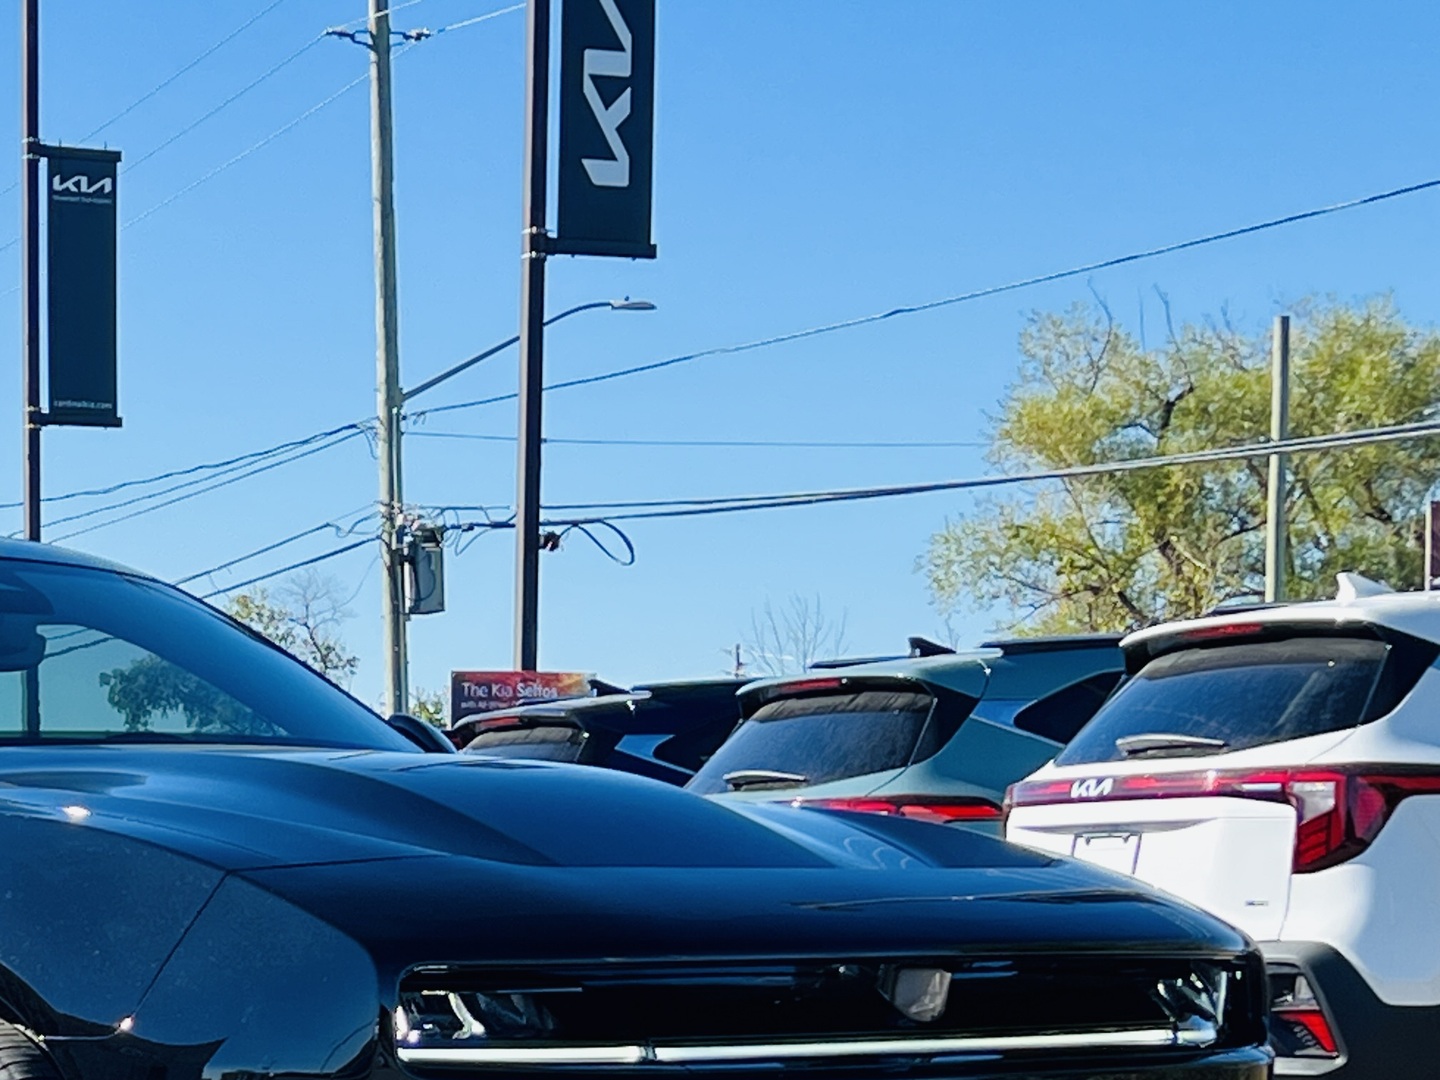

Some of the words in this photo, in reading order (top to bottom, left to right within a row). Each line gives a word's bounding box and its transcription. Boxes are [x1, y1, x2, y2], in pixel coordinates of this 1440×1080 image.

[53, 174, 112, 194] KIA
[461, 682, 488, 697] The
[491, 683, 513, 698] Kia
[516, 680, 558, 699] Seltos
[1070, 778, 1114, 798] KIA
